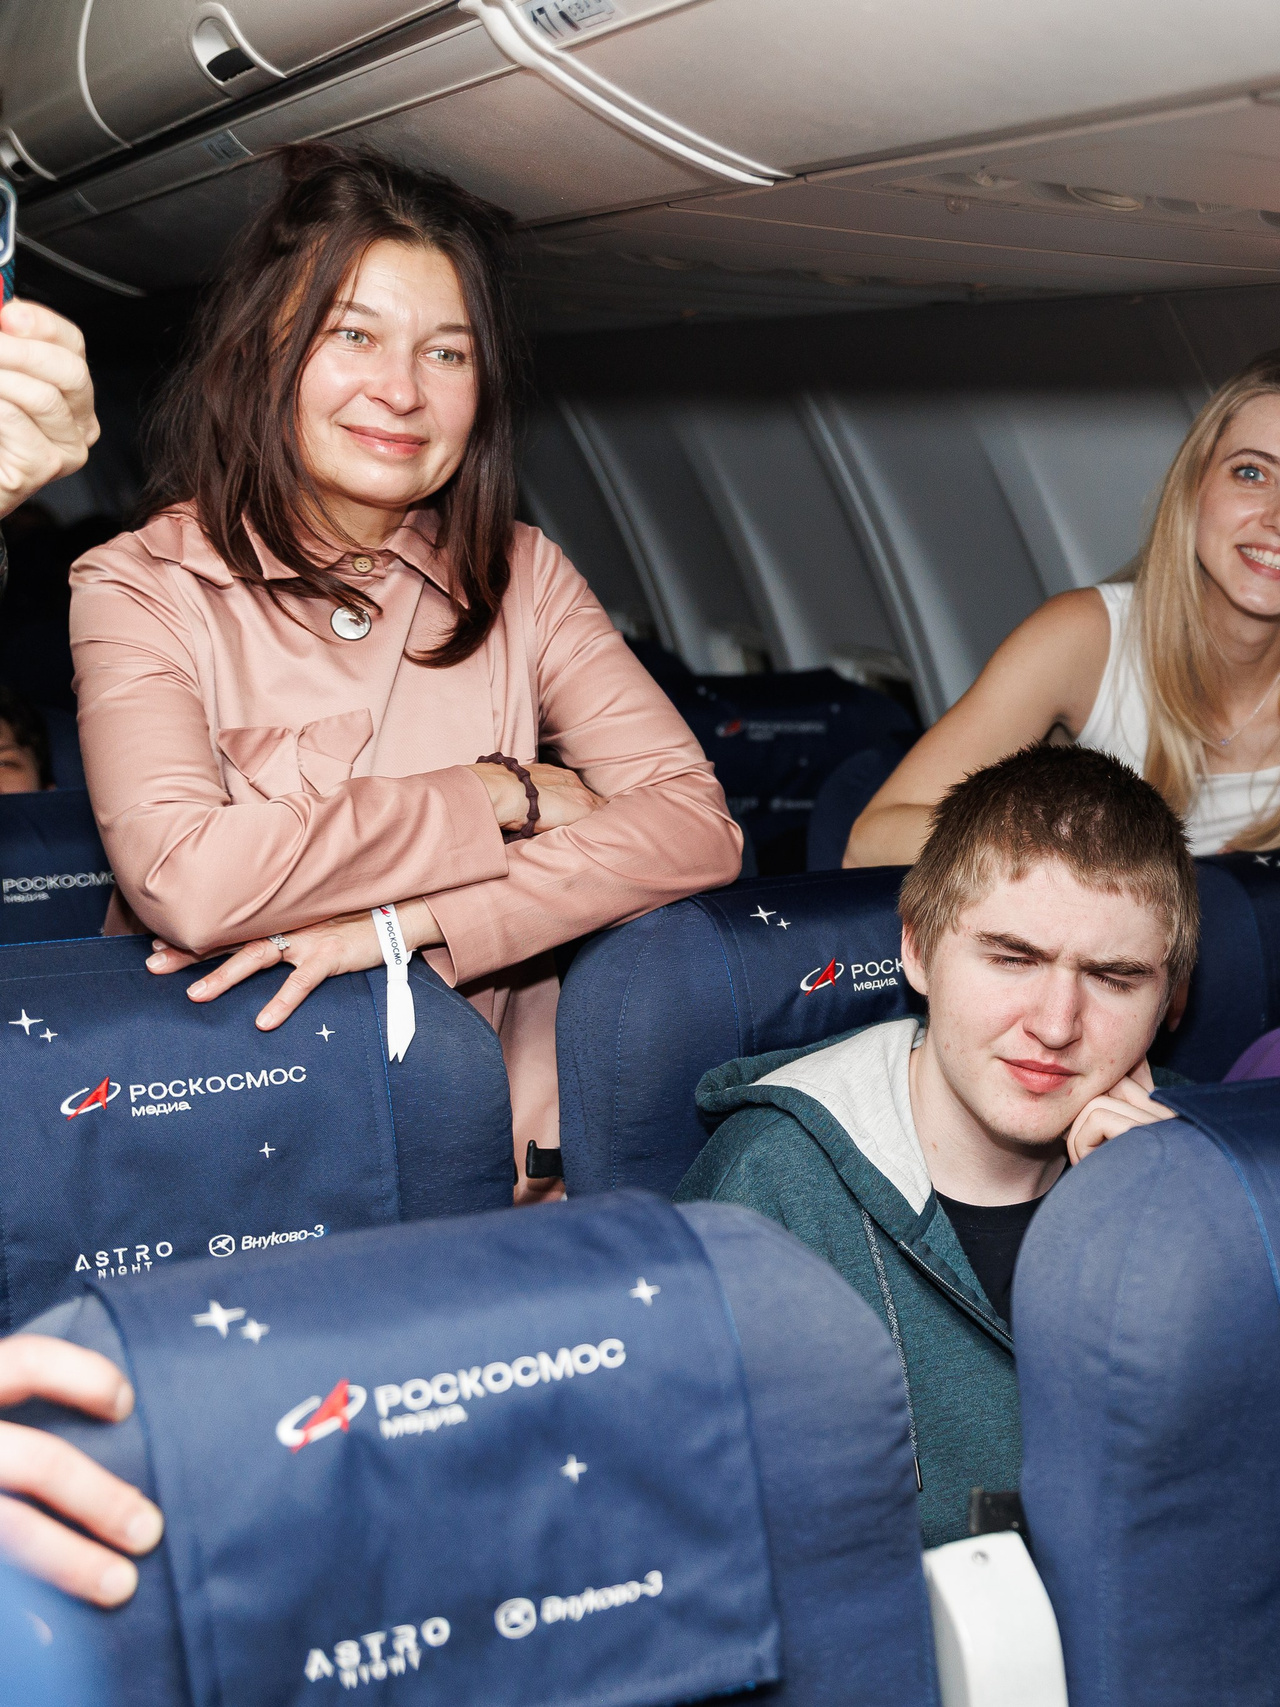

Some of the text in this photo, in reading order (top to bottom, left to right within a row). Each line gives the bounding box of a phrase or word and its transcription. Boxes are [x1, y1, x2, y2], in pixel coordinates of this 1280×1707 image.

[853, 977, 898, 992] медиа
[129, 1065, 308, 1103] РОСКОСМОС
[131, 1100, 192, 1118] медиа
[241, 1224, 325, 1251] Внуково-3
[75, 1241, 173, 1272] ASTRO
[98, 1262, 153, 1280] NIGHT
[374, 1337, 627, 1418] РОСКОСМОС
[304, 1616, 451, 1682] ASTRO
